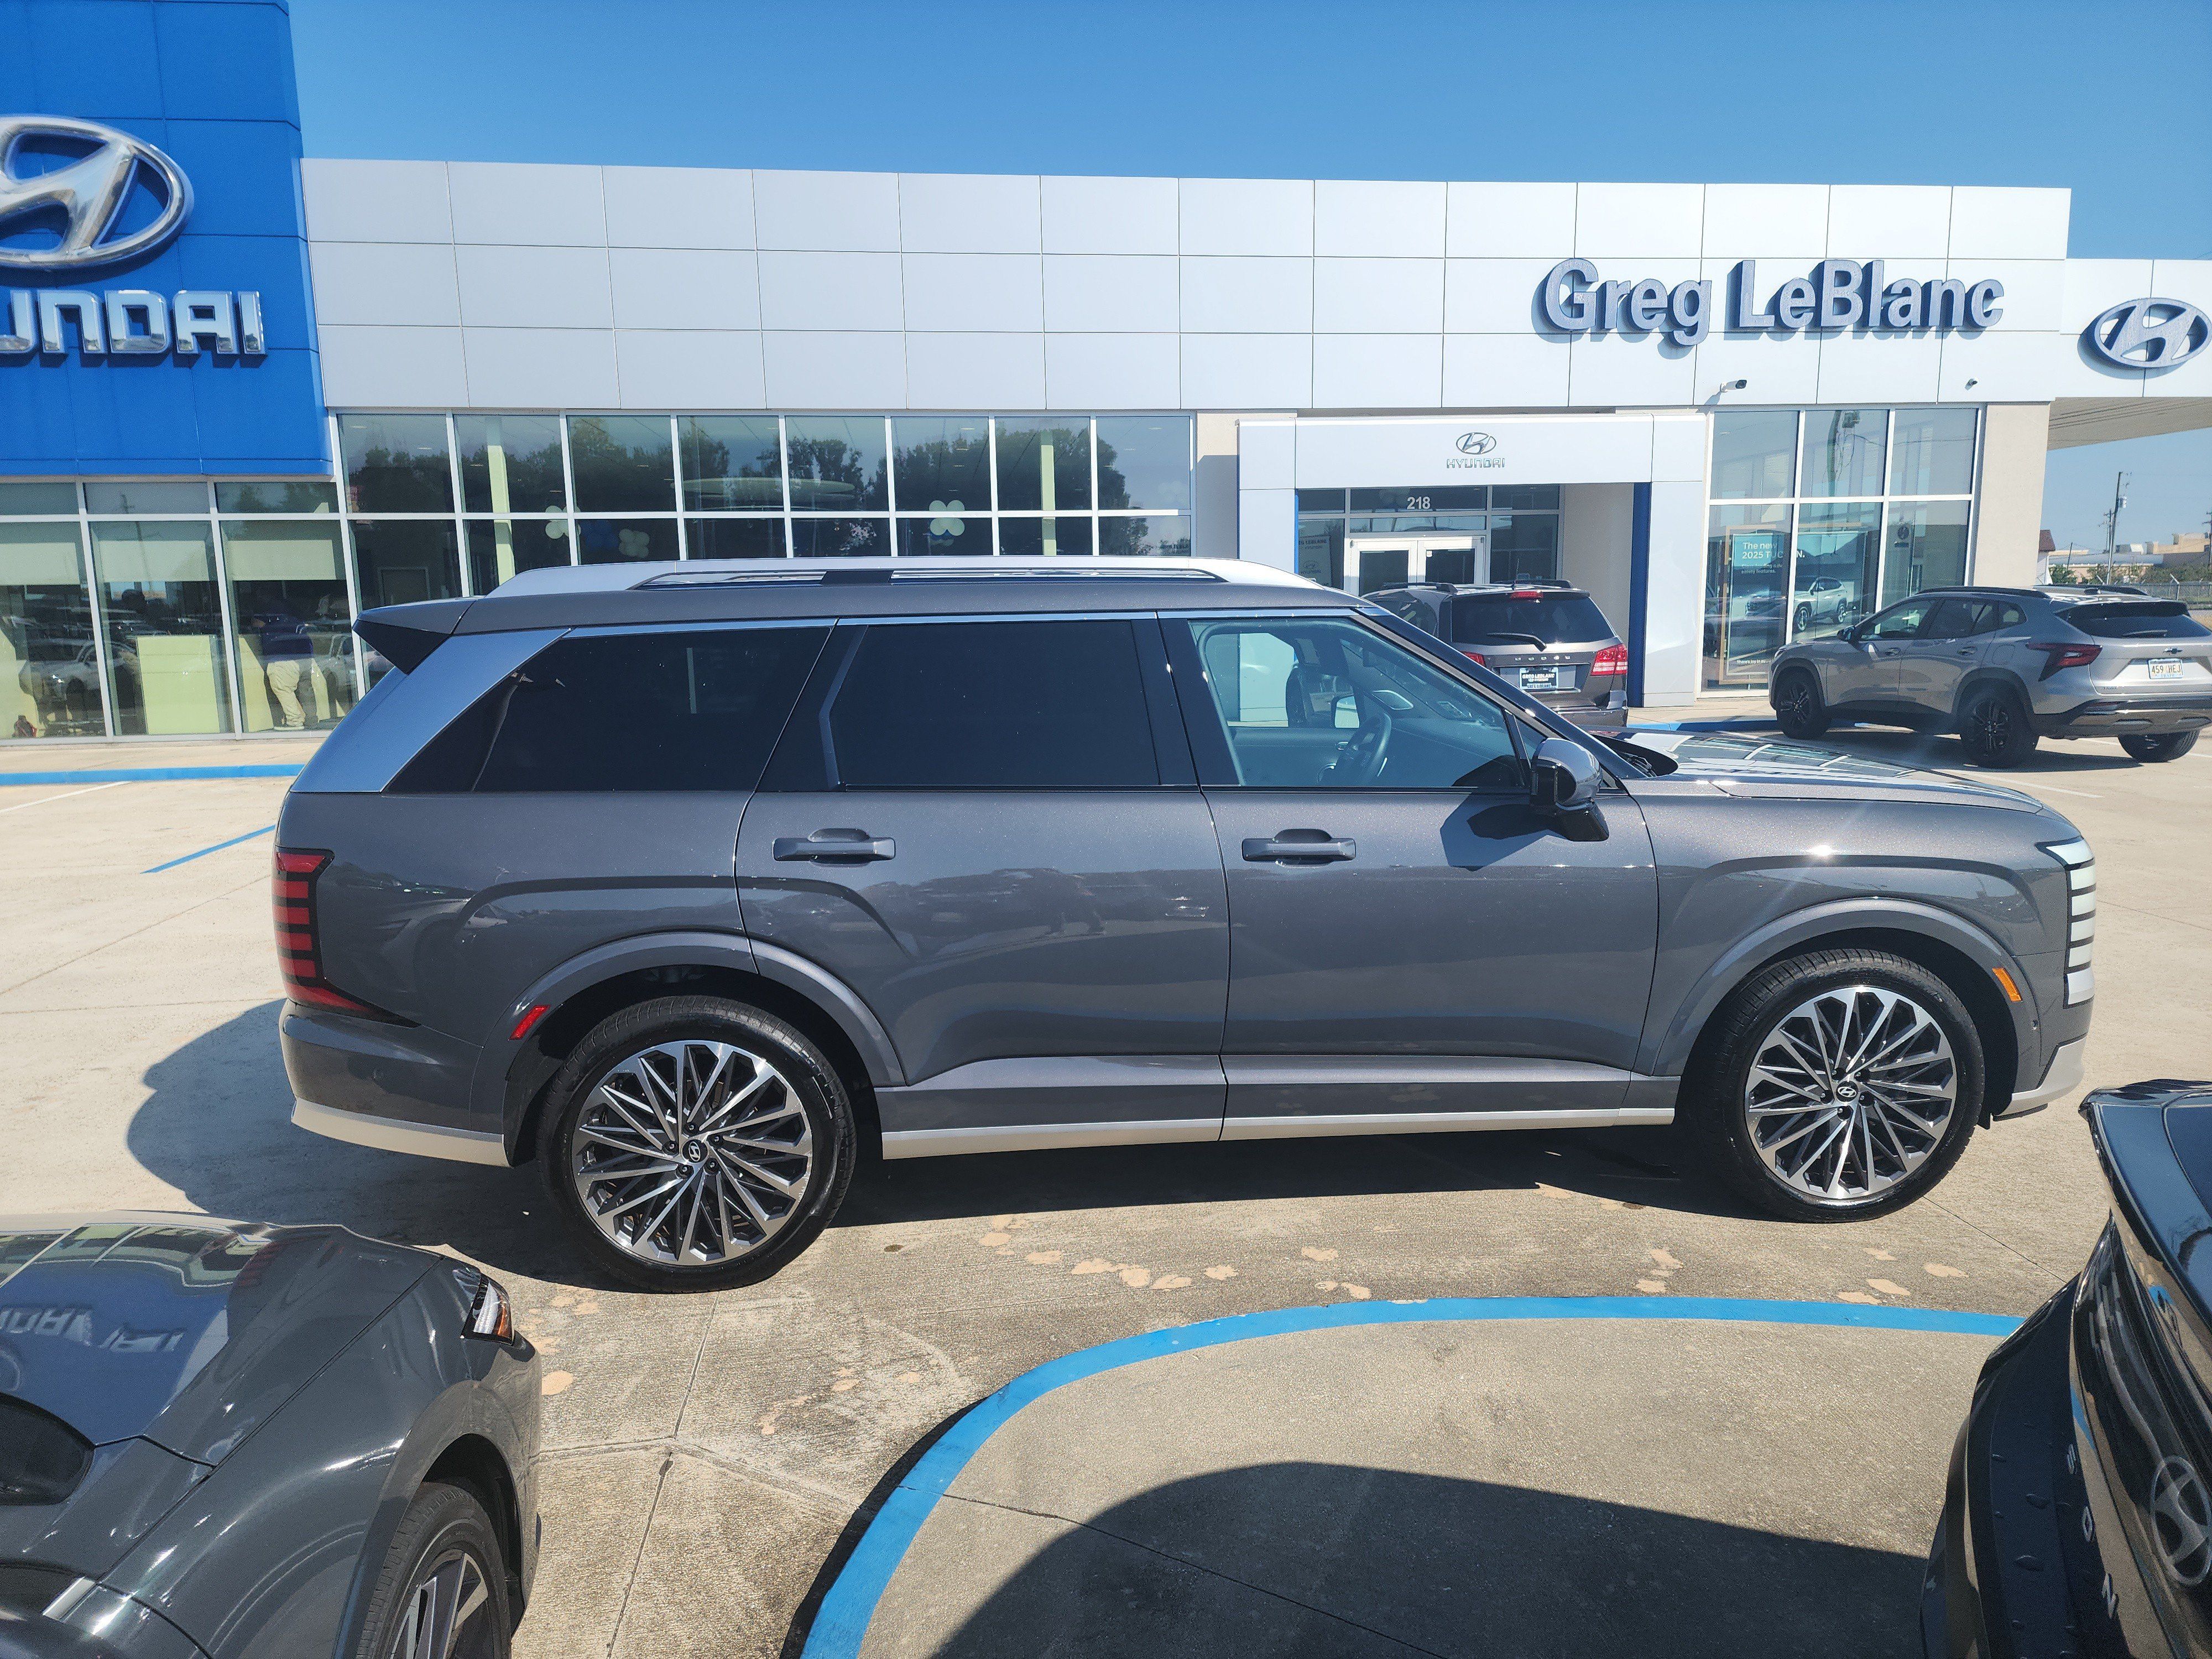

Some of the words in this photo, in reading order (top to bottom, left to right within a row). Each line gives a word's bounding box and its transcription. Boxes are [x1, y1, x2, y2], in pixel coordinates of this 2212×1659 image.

[1545, 258, 1712, 347] Greg
[1739, 259, 2005, 329] LeBlanc
[1447, 457, 1505, 469] HYUNDAI
[1407, 496, 1431, 510] 218
[1743, 541, 1758, 550] The
[1742, 551, 1764, 559] 2025
[1766, 550, 1806, 559] TUCN.
[2152, 665, 2164, 674] 459
[2168, 665, 2181, 673] HEJ
